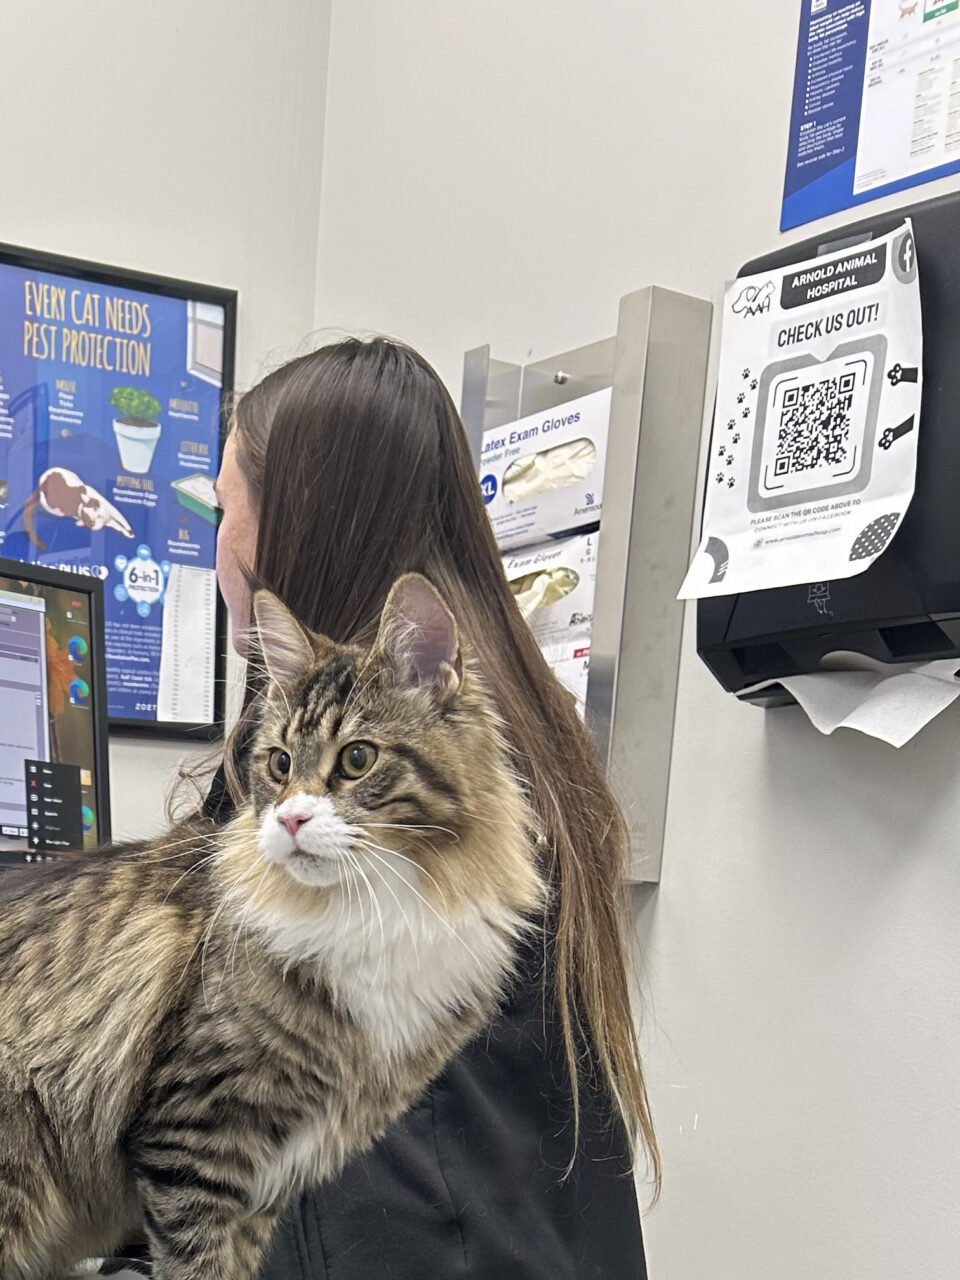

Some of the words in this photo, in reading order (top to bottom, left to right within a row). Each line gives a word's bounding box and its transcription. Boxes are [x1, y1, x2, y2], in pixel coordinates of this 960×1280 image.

[792, 264, 835, 288] ARNOLD
[835, 252, 878, 276] ANIMAL
[807, 274, 857, 299] HOSPITAL
[25, 281, 65, 321] EVERY
[71, 290, 99, 326] CAT
[106, 299, 151, 337] NEEDS
[778, 319, 822, 347] CHECK
[825, 313, 843, 334] US
[847, 302, 879, 326] OUT!
[24, 322, 56, 359] PEST
[63, 329, 151, 377] PROTECTION
[510, 427, 538, 444] Exam
[542, 412, 581, 432] Gloves
[505, 447, 520, 458] Free
[481, 483, 495, 496] XL
[751, 516, 772, 525] PLEASE
[774, 513, 789, 521] SCAN
[813, 505, 829, 514] CODE
[831, 502, 850, 511] ABOVE
[508, 558, 532, 568] Exam
[129, 567, 159, 586] 6-in-1
